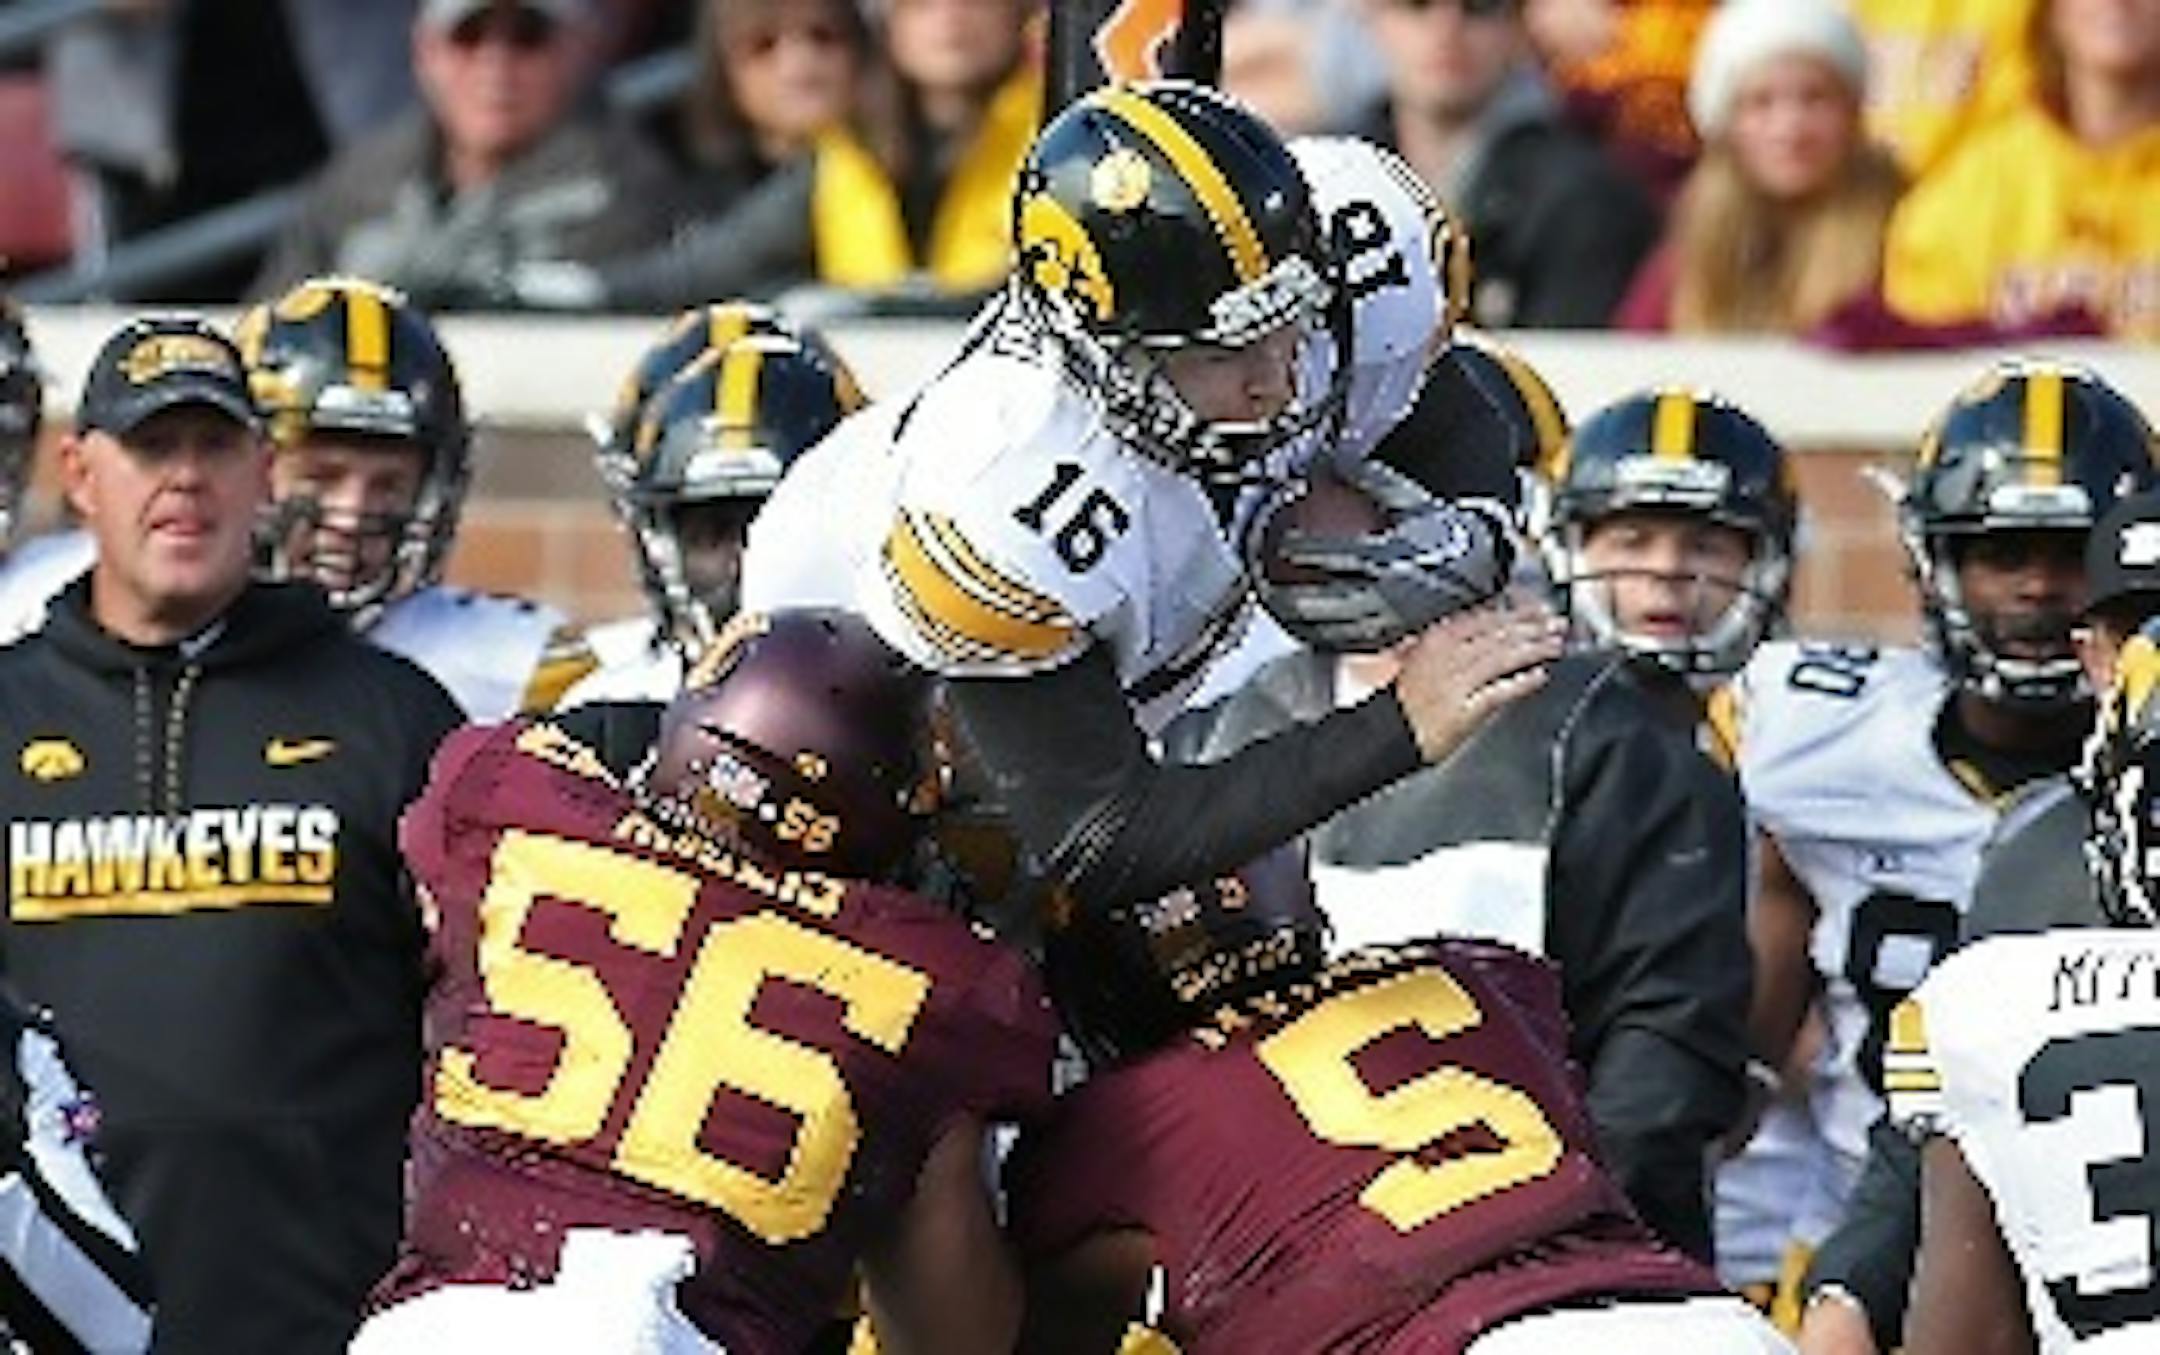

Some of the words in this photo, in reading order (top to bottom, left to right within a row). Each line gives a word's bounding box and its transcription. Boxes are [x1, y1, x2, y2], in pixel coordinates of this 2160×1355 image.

[1012, 463, 1131, 573] 16
[8, 804, 338, 897] HAWKEYES
[774, 796, 842, 853] 56
[433, 826, 933, 1246] 56
[1256, 962, 1564, 1236] 5
